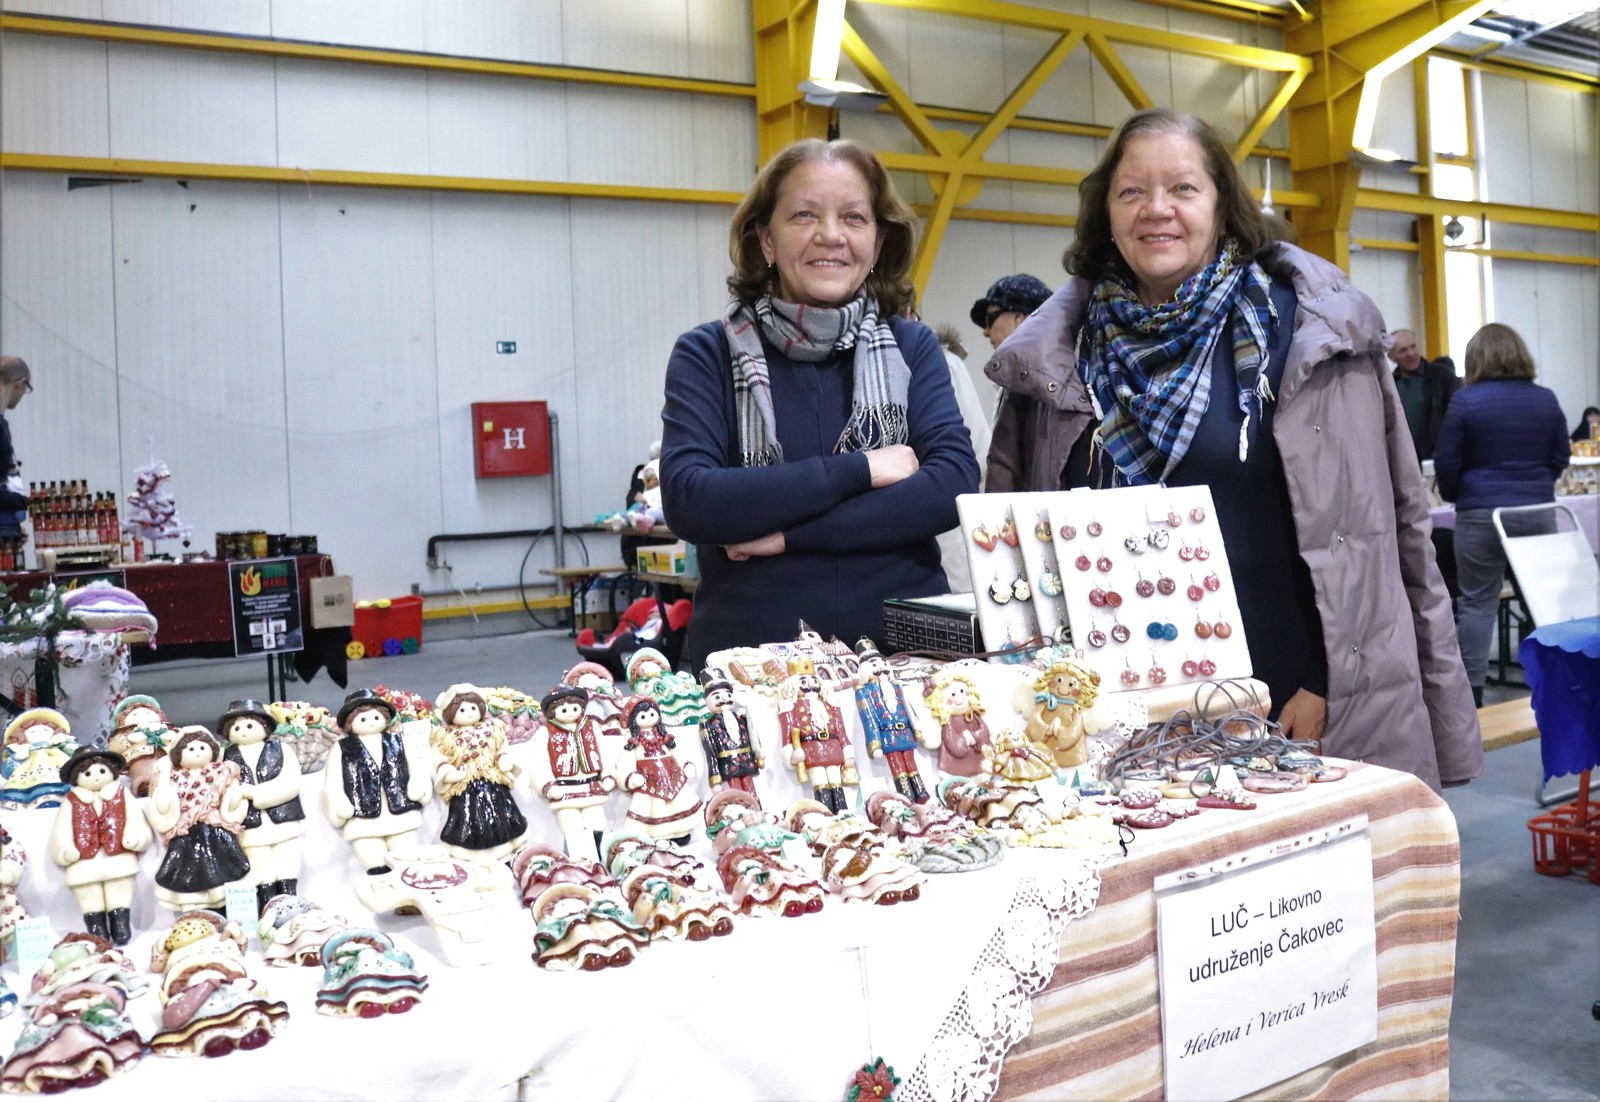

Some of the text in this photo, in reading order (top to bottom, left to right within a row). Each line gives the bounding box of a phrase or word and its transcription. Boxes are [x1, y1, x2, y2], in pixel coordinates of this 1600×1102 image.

[502, 427, 526, 450] H
[1211, 903, 1249, 938] LUČ
[1269, 888, 1322, 919] Likovno
[1189, 916, 1344, 983] udruženje Čakovec
[1180, 978, 1350, 1059] Helena i Verica Vresk
